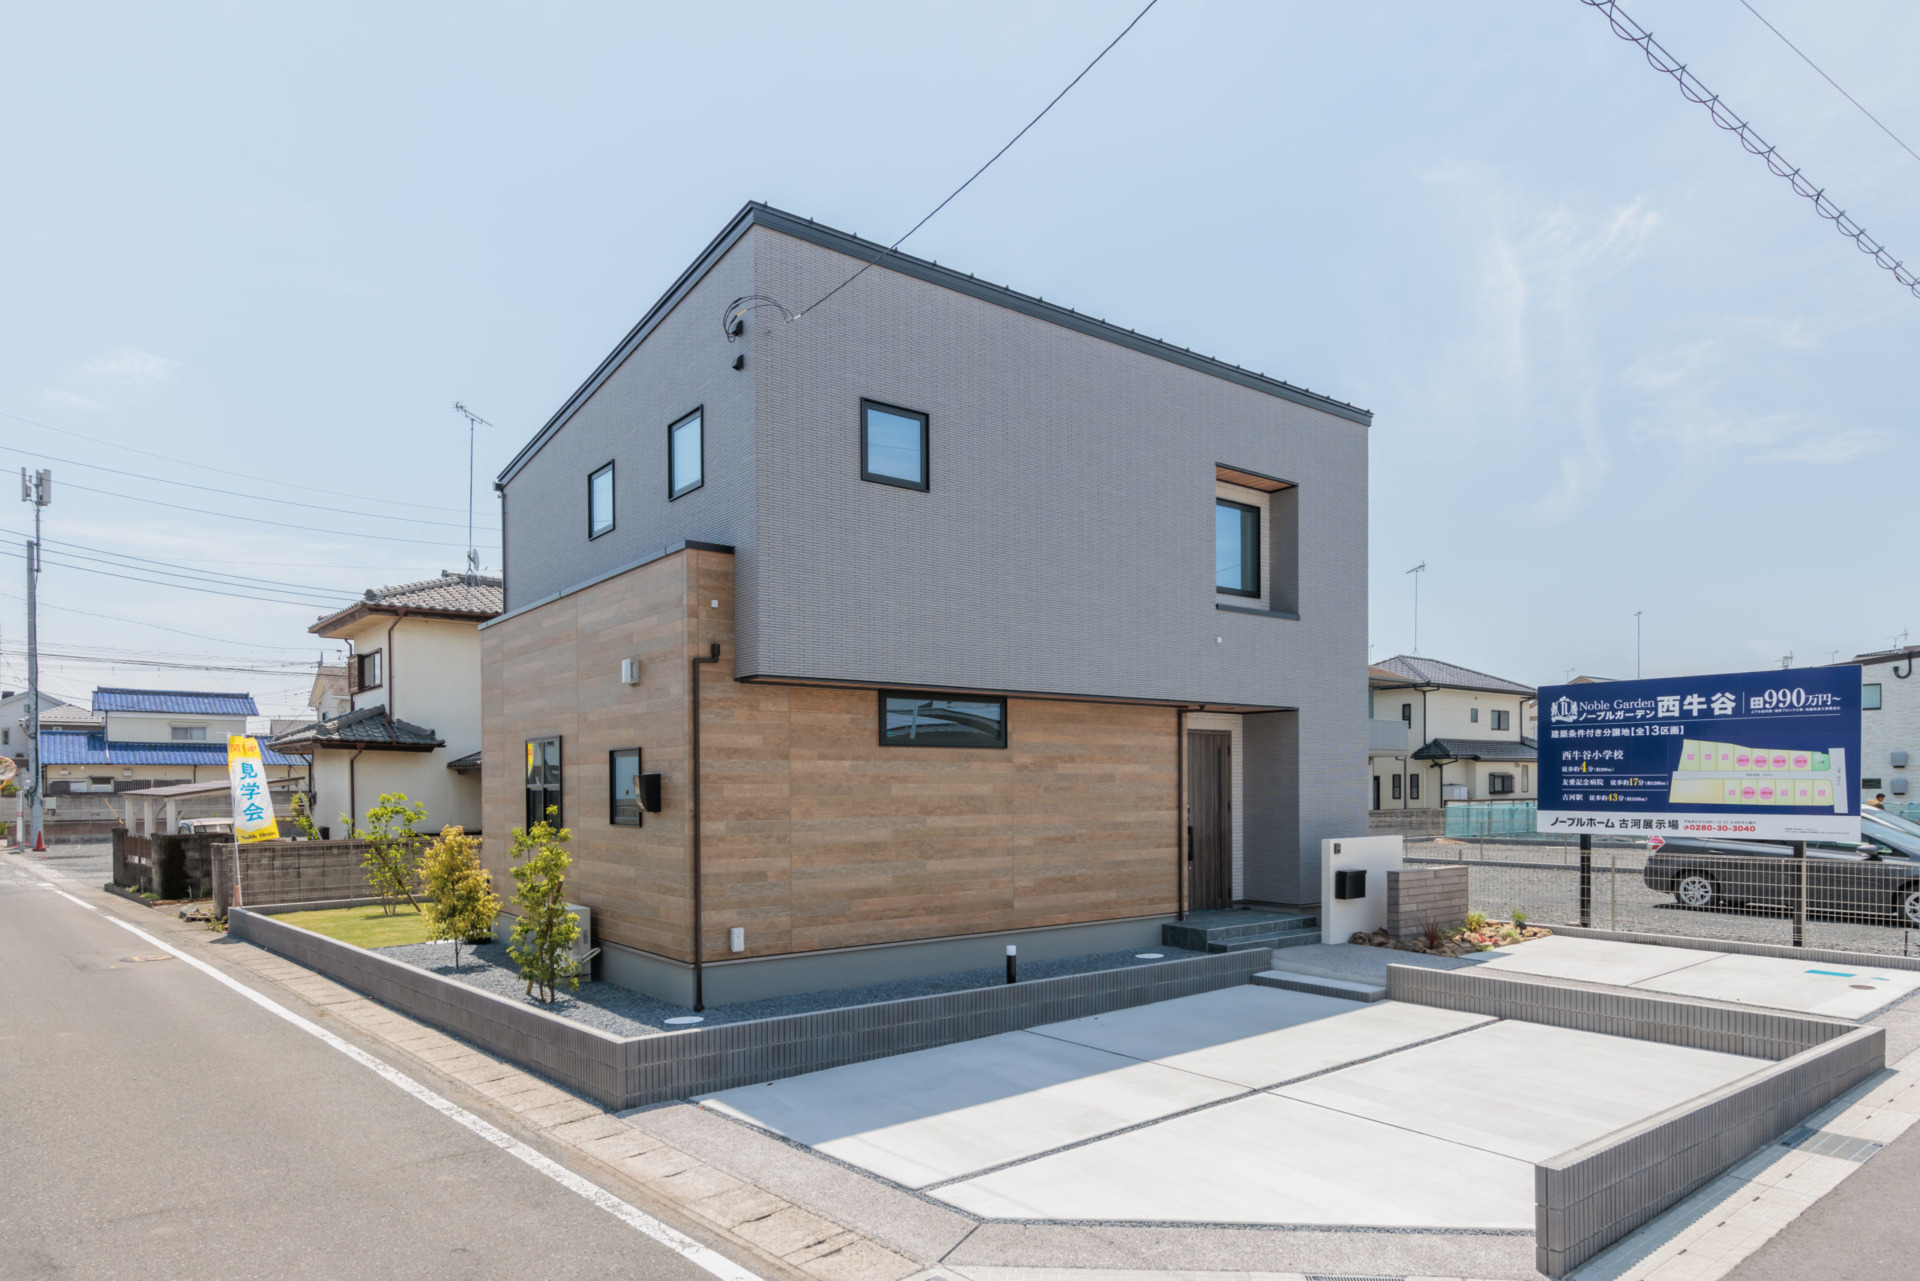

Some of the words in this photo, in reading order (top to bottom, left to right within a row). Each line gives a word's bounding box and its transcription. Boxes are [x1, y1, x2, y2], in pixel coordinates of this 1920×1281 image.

[1579, 701, 1610, 711] Noble
[1613, 699, 1655, 709] Garden
[1656, 692, 1737, 717] 西牛谷
[1578, 709, 1656, 721] ノーブルガーデン
[1562, 749, 1624, 760] 西牛谷小学校
[240, 762, 264, 822] 見学会
[1562, 793, 1583, 801] 古河駅
[1550, 816, 1615, 828] ノーブルホーム
[1618, 818, 1680, 830] 古河展示場
[1689, 824, 1756, 833] 0280-30-3040
